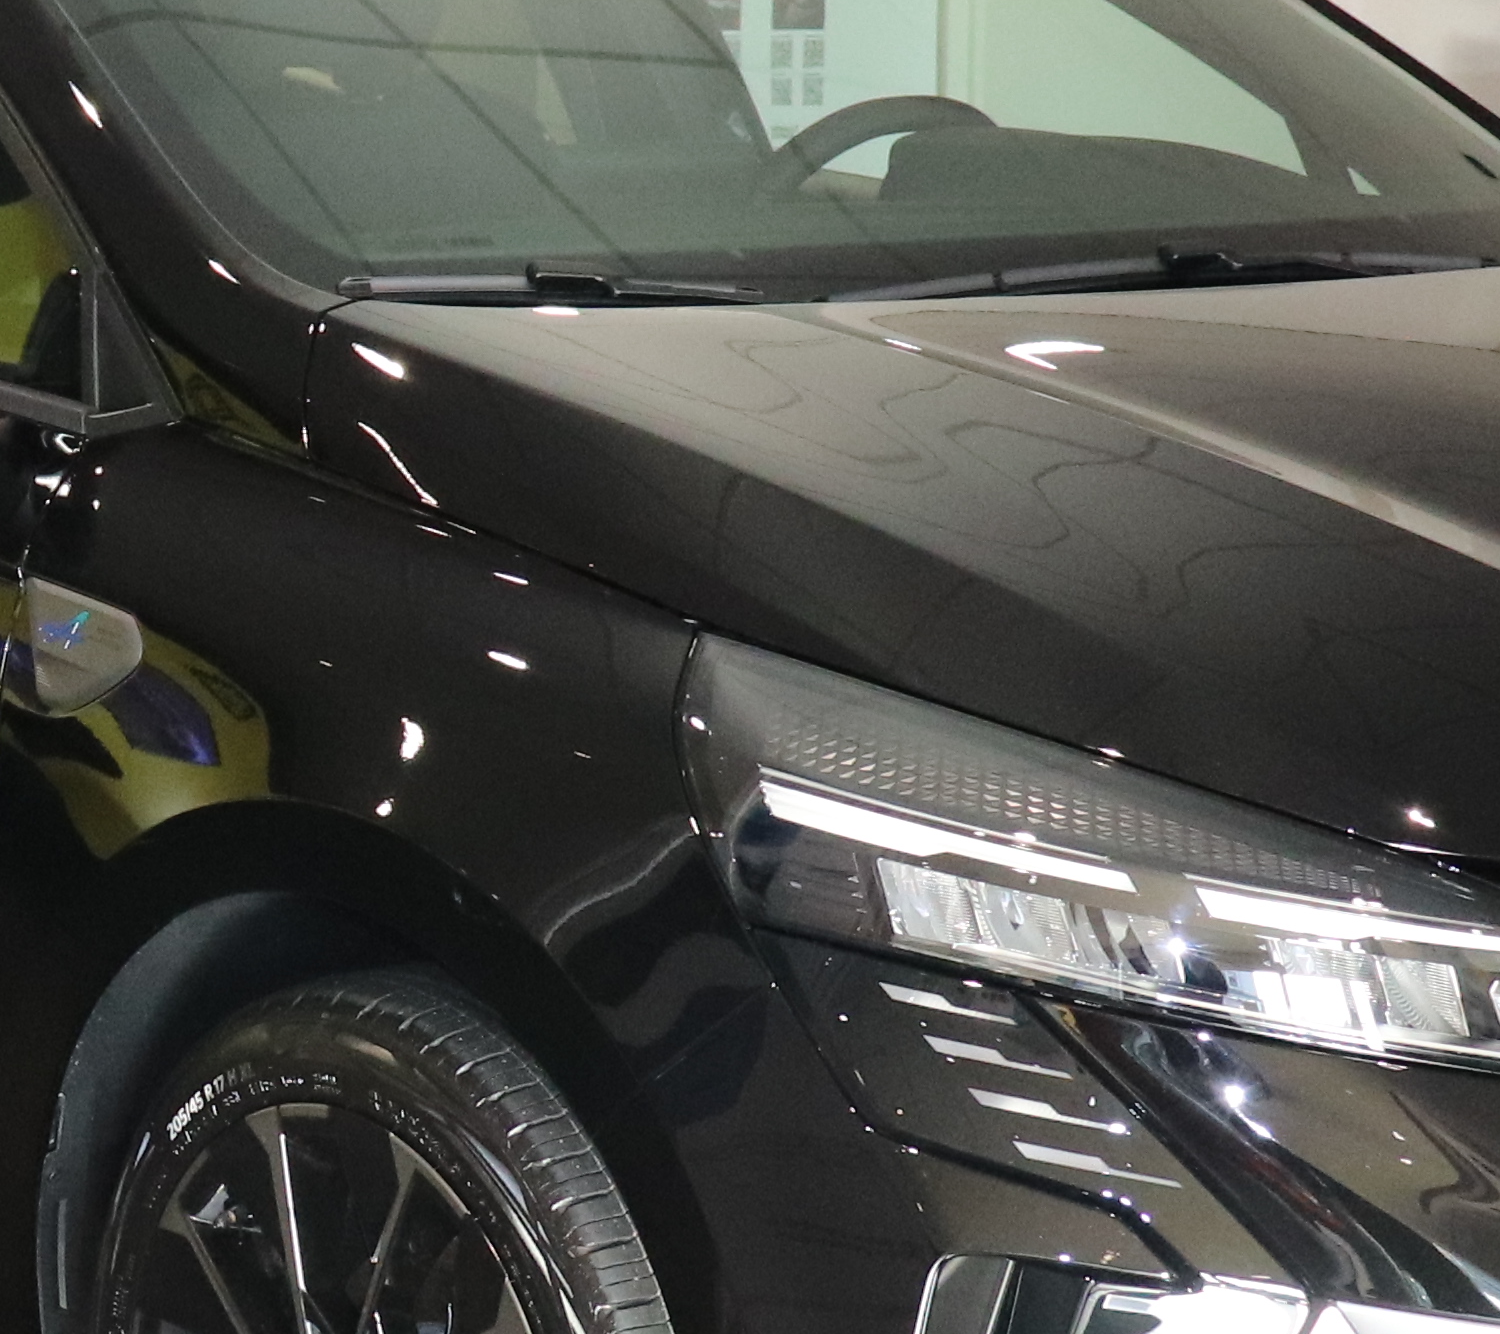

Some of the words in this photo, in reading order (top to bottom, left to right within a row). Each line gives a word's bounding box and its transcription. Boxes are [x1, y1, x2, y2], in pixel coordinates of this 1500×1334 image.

[166, 1089, 204, 1142] 205/45
[203, 1082, 214, 1103] R
[213, 1073, 225, 1095] 17
